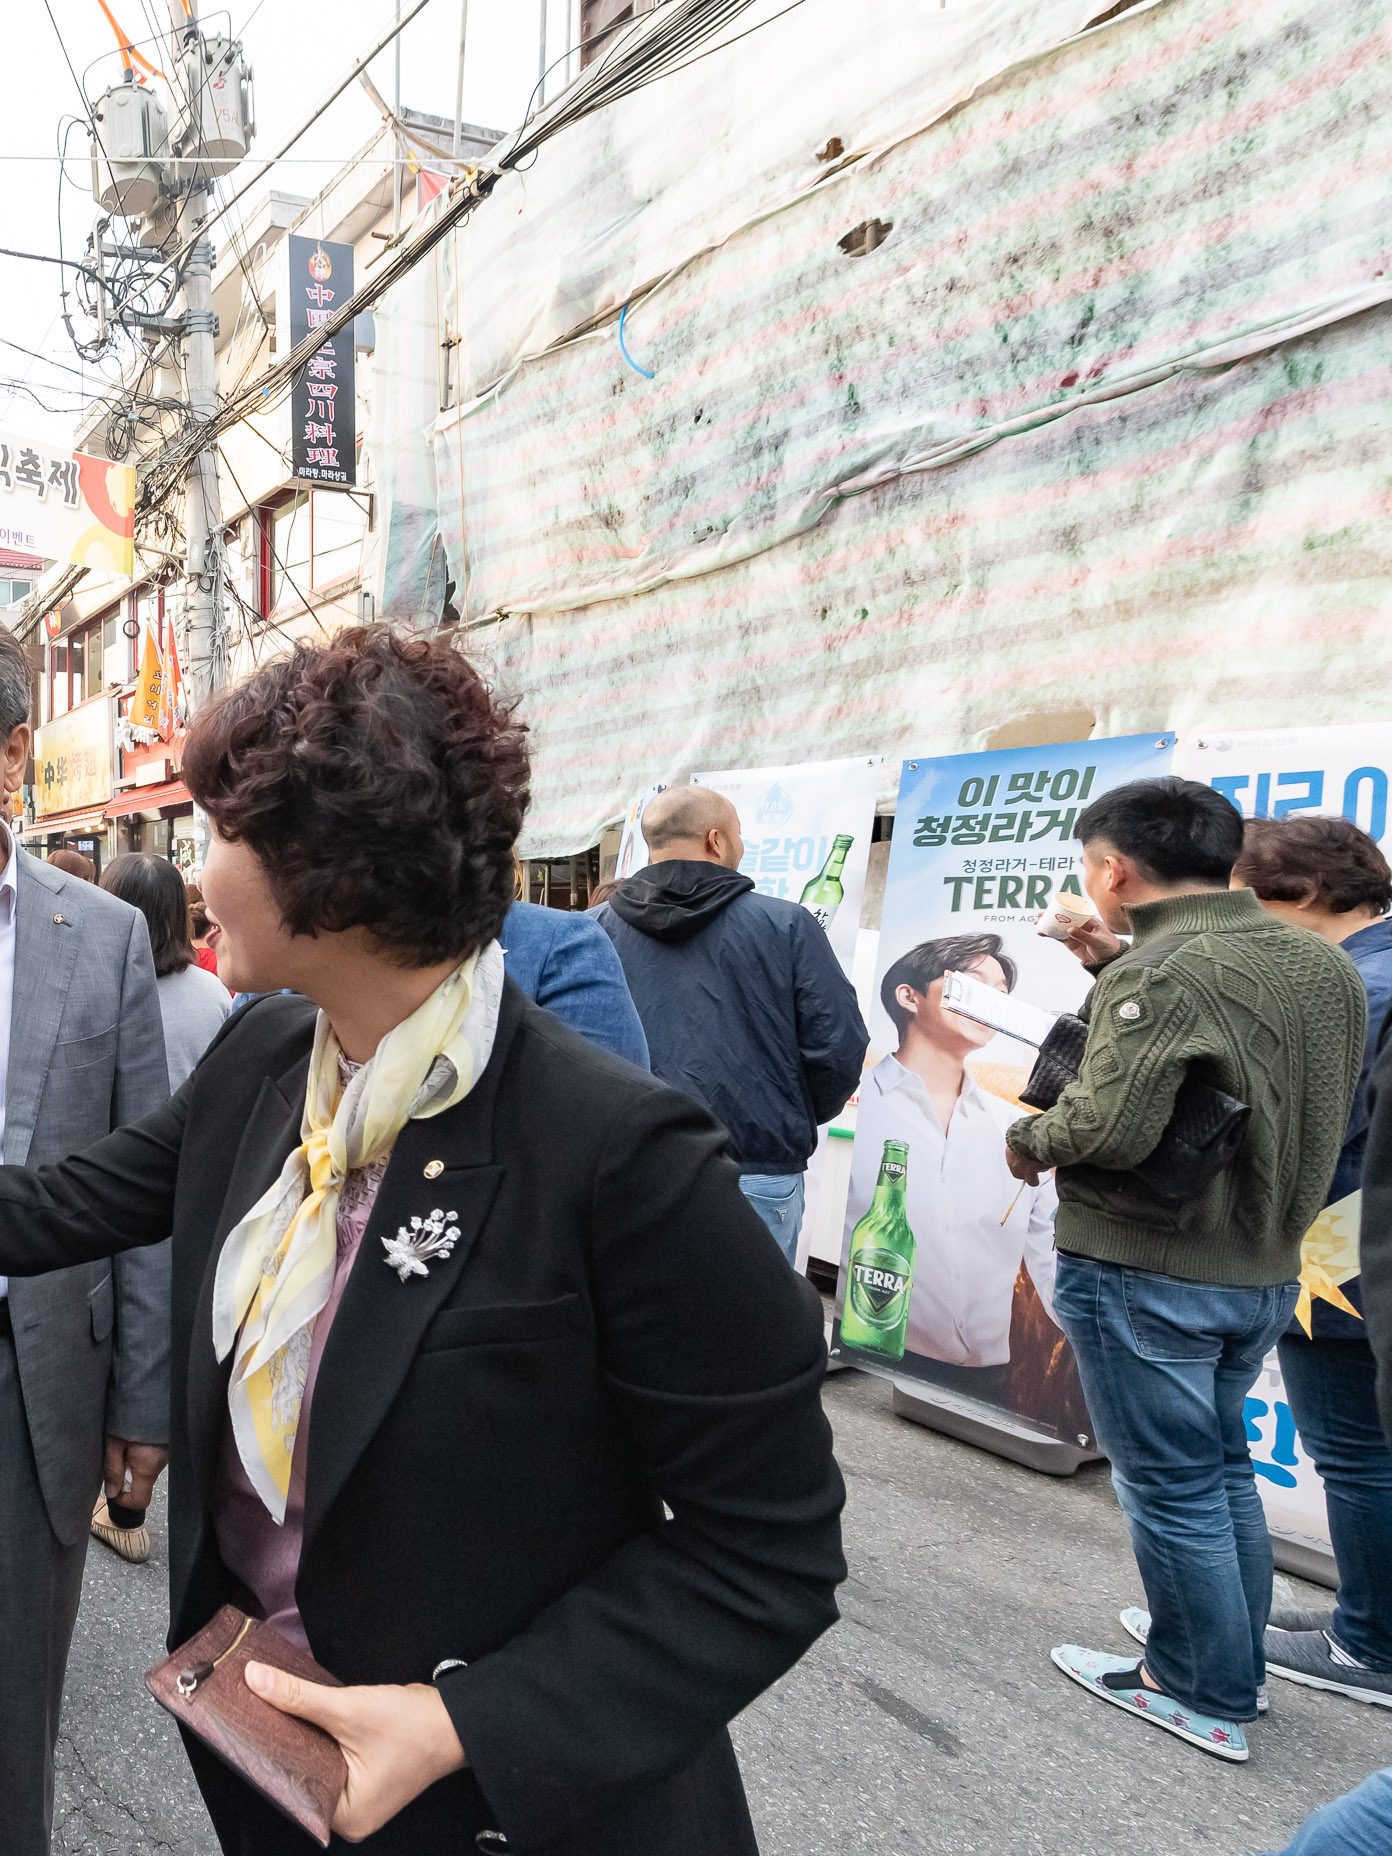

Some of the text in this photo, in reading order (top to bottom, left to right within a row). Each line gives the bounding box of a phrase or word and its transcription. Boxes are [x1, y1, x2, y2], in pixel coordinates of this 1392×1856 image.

[957, 765, 1098, 808] 이 맛이
[912, 807, 1088, 848] 청정라거
[962, 856, 1076, 874] 청정라거-테라
[943, 873, 1084, 913] TERRA
[983, 915, 1016, 923] FROM
[881, 1161, 907, 1175] TERRA
[854, 1264, 905, 1295] TERRA
